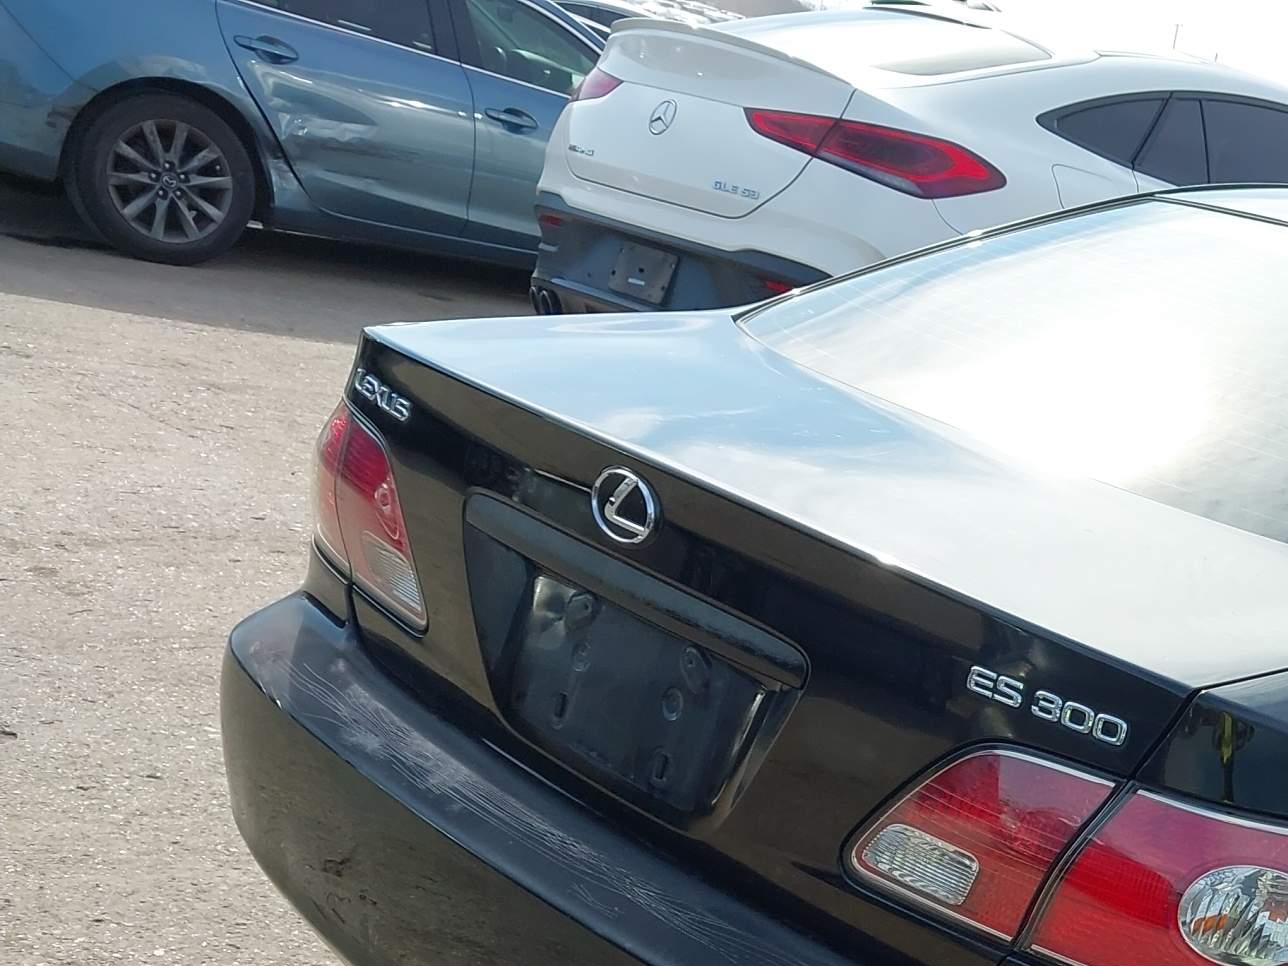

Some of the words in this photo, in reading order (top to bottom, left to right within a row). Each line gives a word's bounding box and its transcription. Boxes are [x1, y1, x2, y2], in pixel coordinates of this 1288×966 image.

[355, 367, 411, 421] LEXUS
[966, 665, 1024, 708] ES
[1030, 690, 1128, 746] 300
